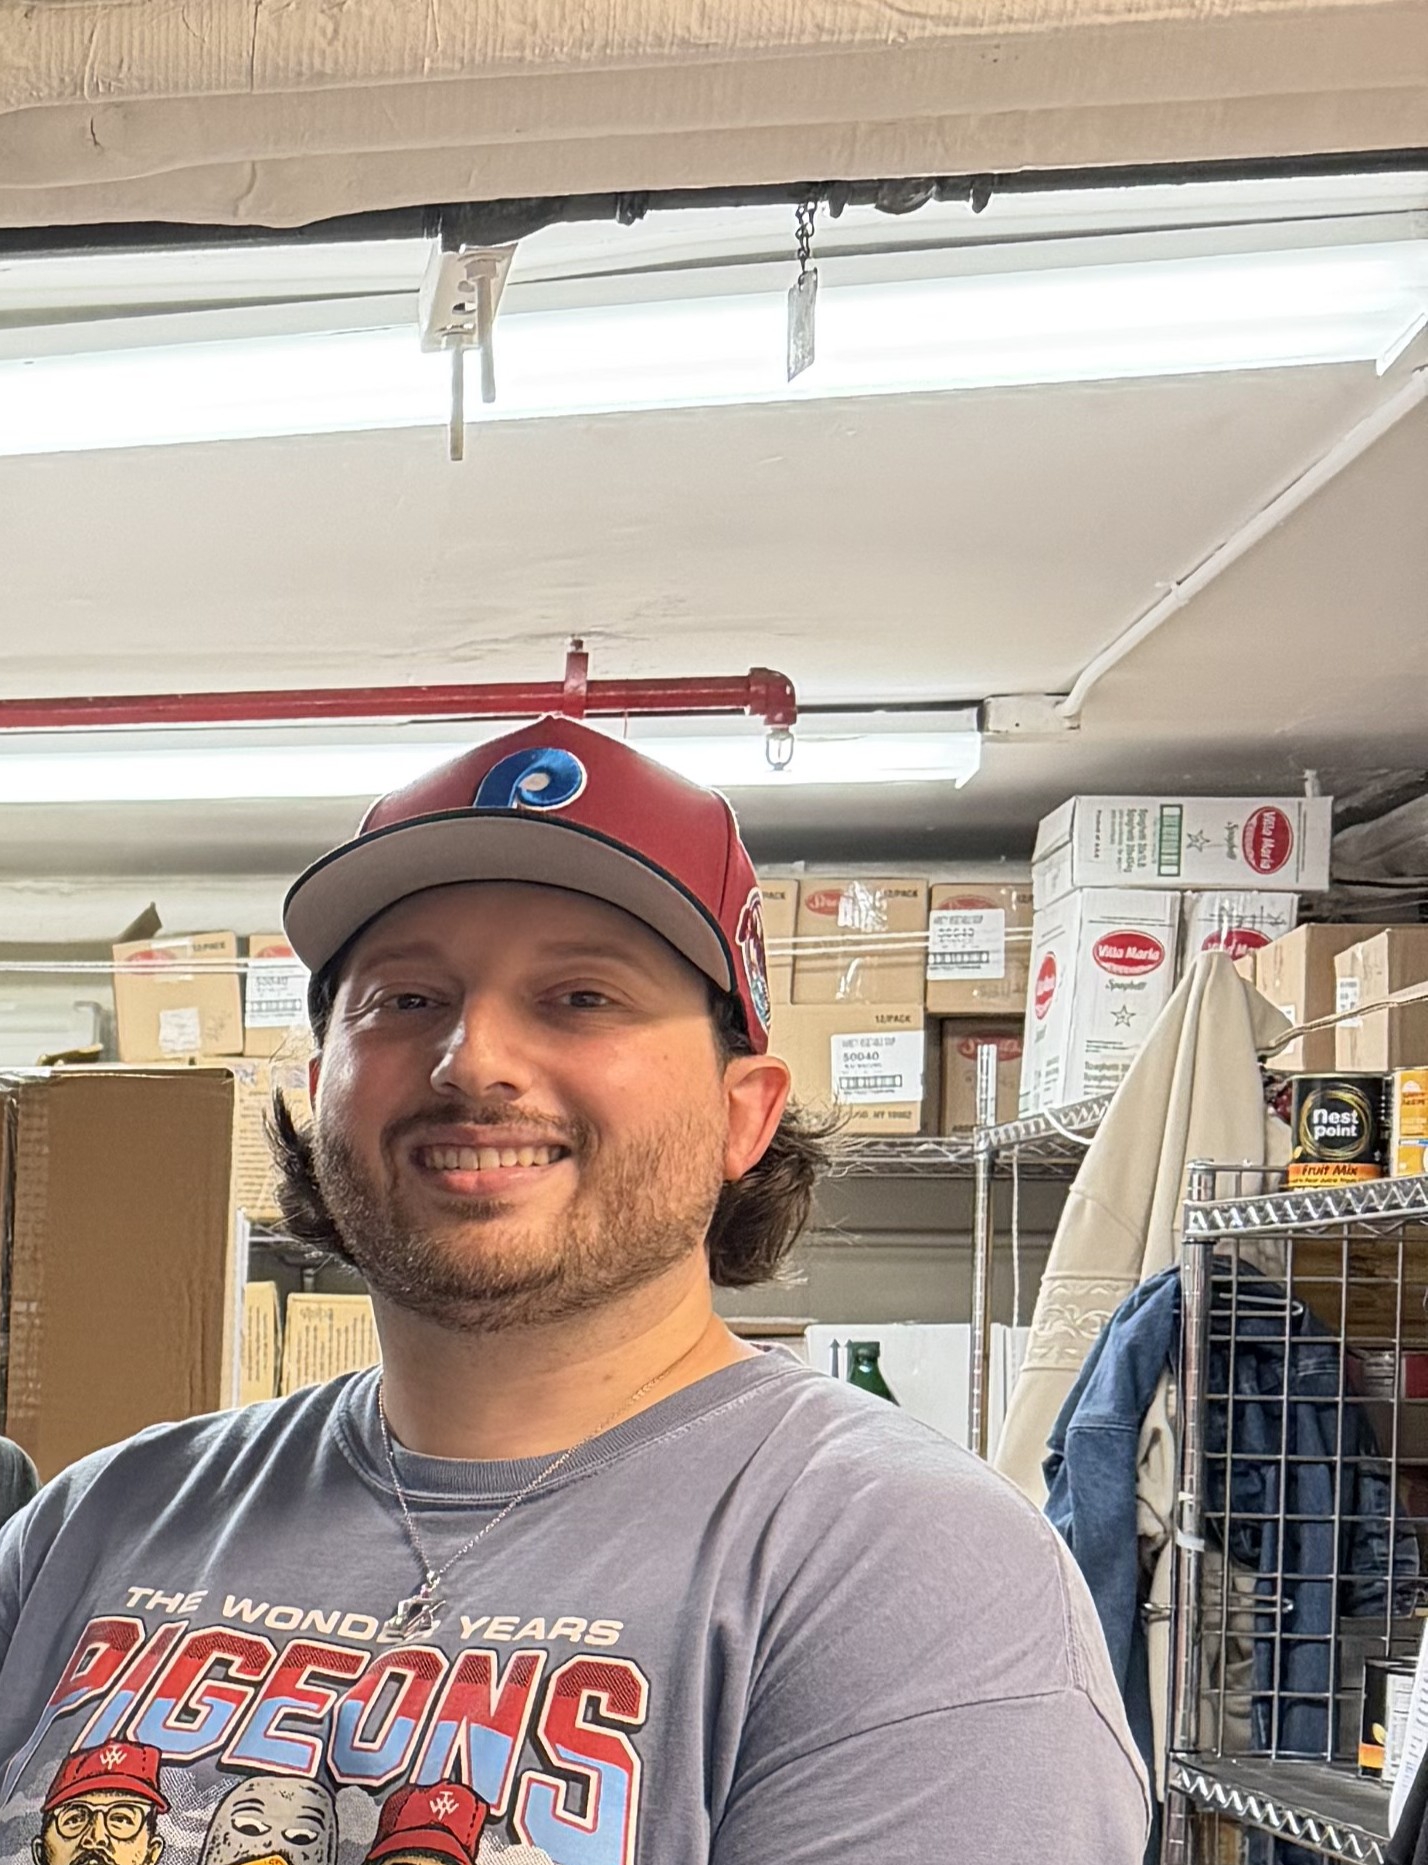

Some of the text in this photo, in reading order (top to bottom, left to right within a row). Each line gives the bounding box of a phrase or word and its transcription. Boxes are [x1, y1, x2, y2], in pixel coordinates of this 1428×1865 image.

[1127, 946, 1160, 961] Maria
[1313, 1108, 1359, 1124] nest
[1314, 1124, 1357, 1140] point
[1302, 1165, 1357, 1175] Fruit Mix
[126, 1586, 208, 1615] THE
[459, 1614, 624, 1646] YEARS
